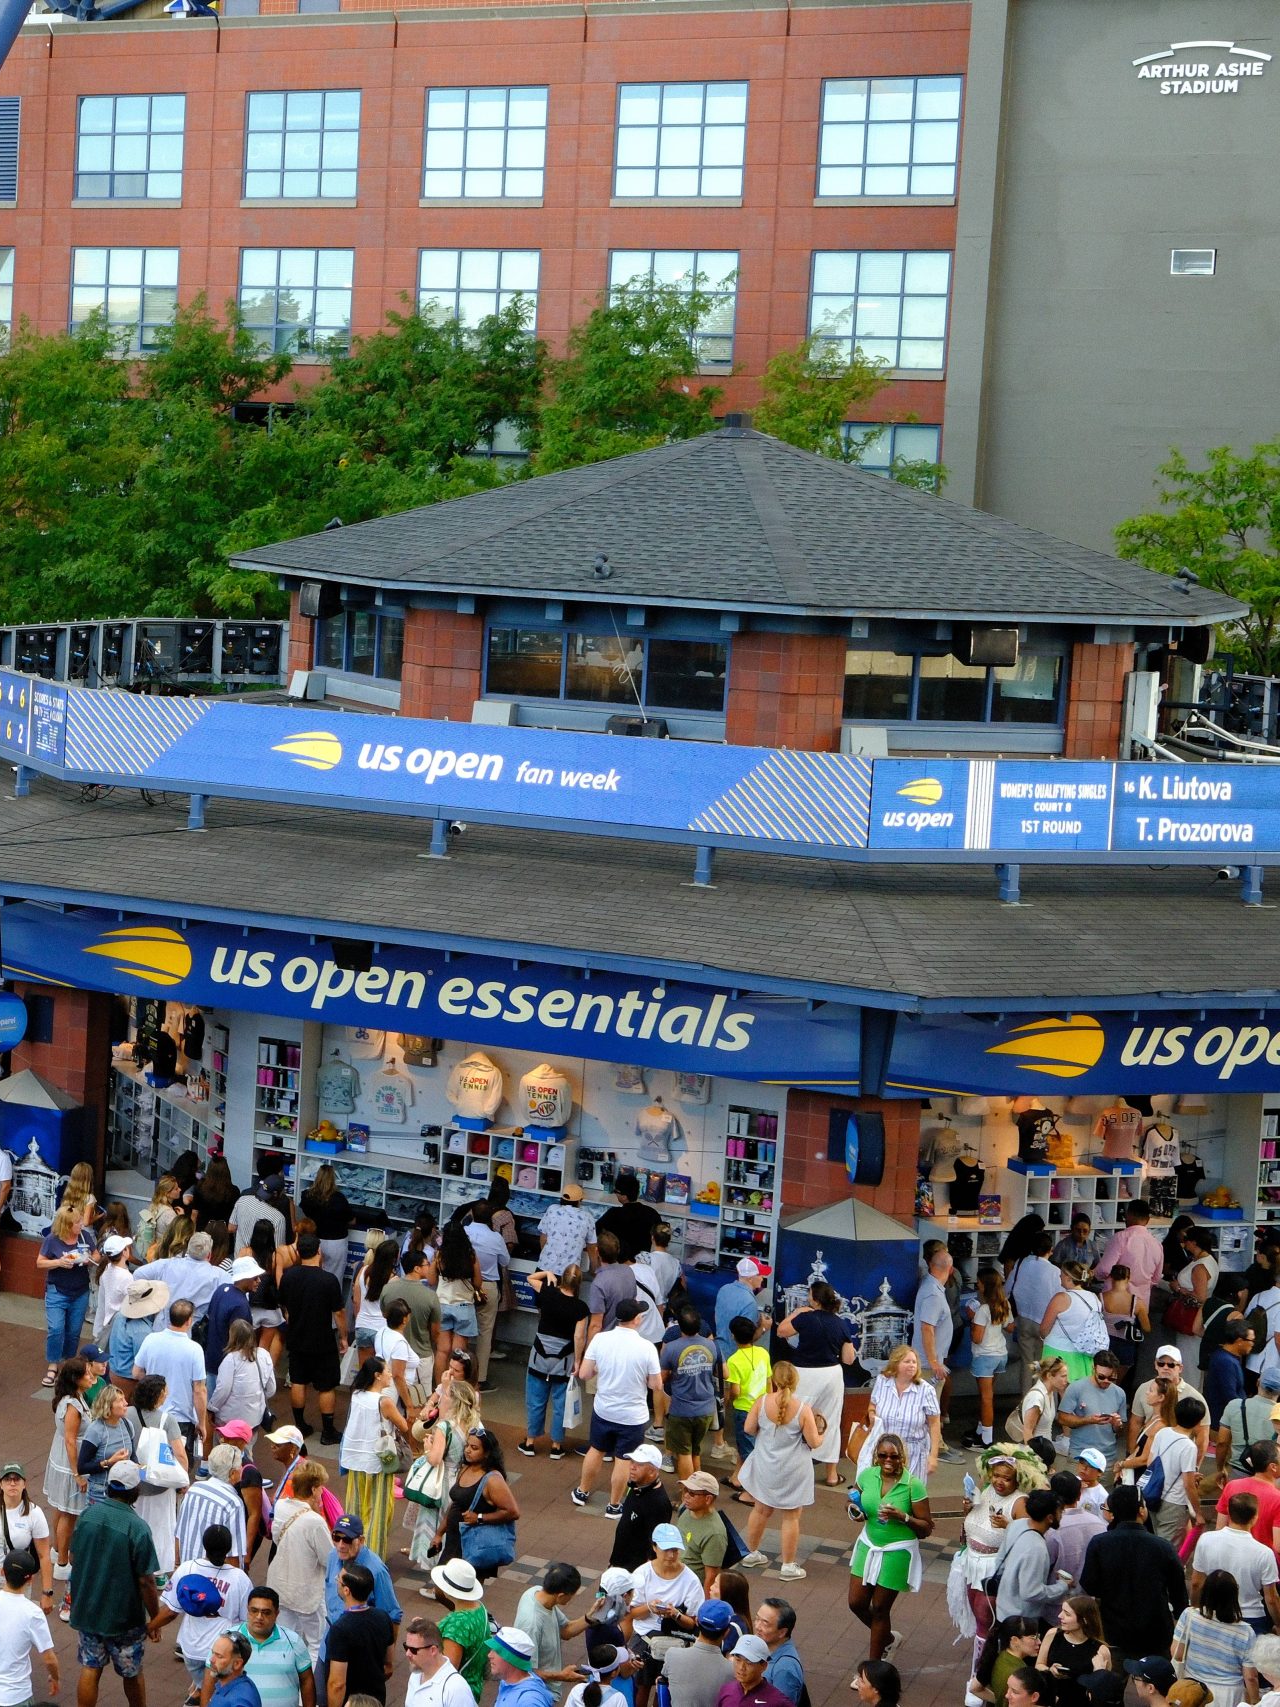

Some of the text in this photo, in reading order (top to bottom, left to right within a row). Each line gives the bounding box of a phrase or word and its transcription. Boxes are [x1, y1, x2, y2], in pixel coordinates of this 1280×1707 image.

[1138, 62, 1263, 78] ARTHUR ASHE
[1160, 80, 1238, 94] STADIUM
[8, 685, 14, 704] 4
[20, 688, 25, 708] 6
[6, 720, 12, 739] 6
[18, 723, 23, 744] 2
[357, 743, 621, 791] us open fan week
[1000, 783, 1107, 799] WOMEN'S QUALIFYING SINGLES
[1124, 776, 1232, 800] 16 K. Liutova
[1033, 802, 1072, 813] COURT 8
[882, 812, 954, 832] us open
[1021, 820, 1082, 834] 1ST ROUND
[1136, 817, 1253, 842] T. Prozorova
[210, 946, 755, 1051] us open essentials
[1120, 1026, 1193, 1067] us
[460, 1082, 488, 1091] TENNIS
[470, 1077, 488, 1085] OPEN
[527, 1091, 557, 1101] TENNIS
[537, 1087, 558, 1095] OPEN
[539, 1104, 553, 1115] NYC
